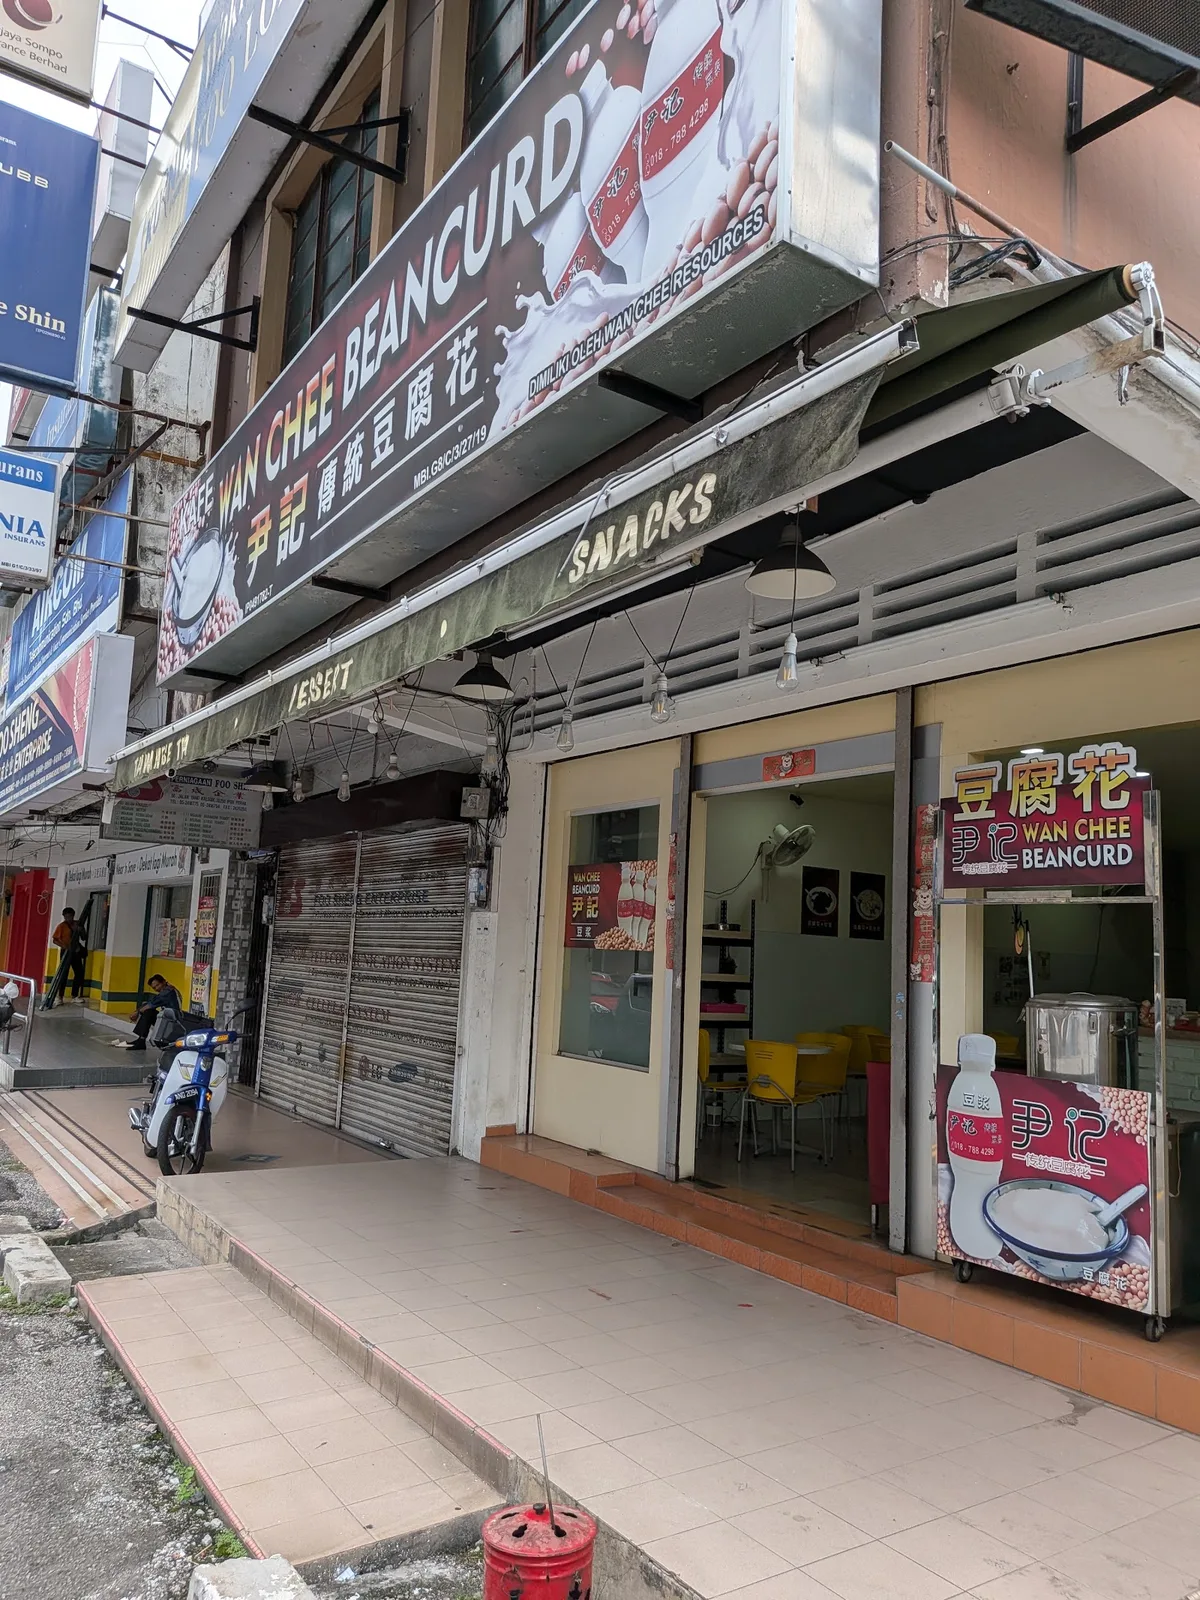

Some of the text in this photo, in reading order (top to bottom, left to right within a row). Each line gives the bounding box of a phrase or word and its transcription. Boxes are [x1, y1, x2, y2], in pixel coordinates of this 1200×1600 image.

[25, 37, 63, 59] Sompo
[29, 51, 68, 74] Berhad
[650, 148, 663, 166] 018
[670, 125, 687, 149] 788
[689, 98, 708, 129] 4298
[179, 93, 583, 537] KAFE WAN CHEE BEANCURD
[528, 205, 764, 399] DIMILIKI OLEH WAN CHEE RESOURCES
[15, 304, 66, 335] Shin
[317, 325, 479, 520] 傳統豆腐花
[413, 424, 488, 490] MBI.G8/C/3/27/19
[4, 532, 46, 547] INSURANS
[246, 473, 309, 588] 尹記
[569, 473, 717, 584] SNACKS
[9, 698, 40, 750] SHENG
[215, 780, 231, 789] FOO
[953, 749, 1131, 822] 豆腐花
[1022, 817, 1131, 843] WAN CHEE
[1022, 844, 1133, 869] BEANCURD
[572, 884, 600, 894] BEANCURD
[587, 872, 600, 882] CHEE
[572, 896, 599, 918] 尹記
[962, 1092, 991, 1111] 豆浆
[968, 1145, 979, 1155] 788
[1024, 1151, 1092, 1180] 传统豆腐花
[1081, 1266, 1129, 1291] 豆腐花
